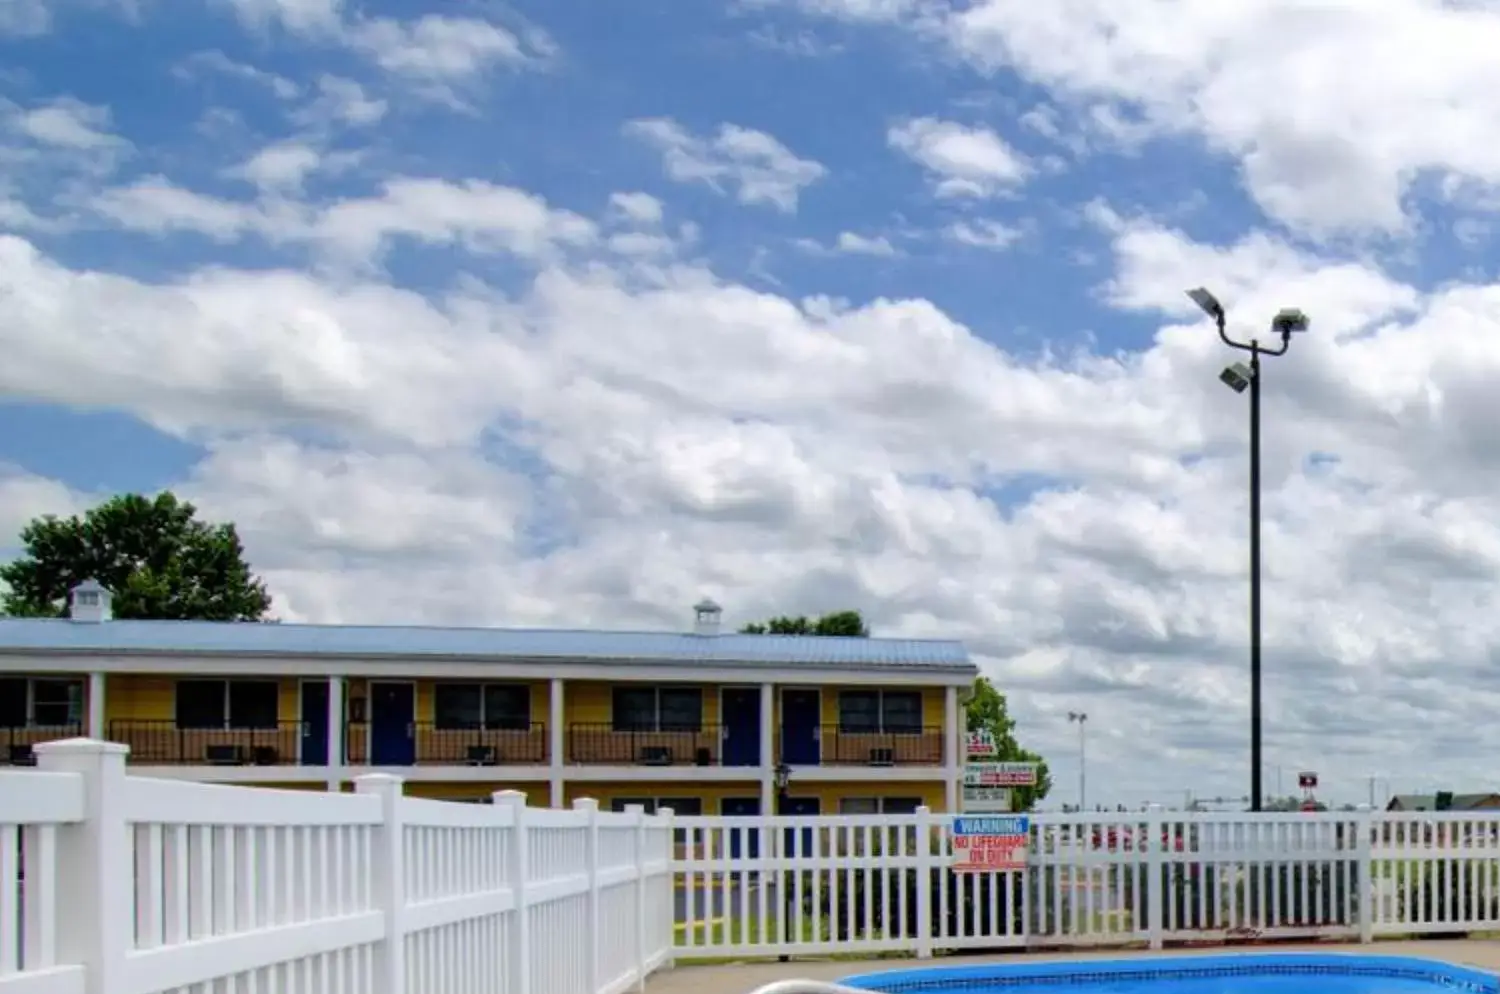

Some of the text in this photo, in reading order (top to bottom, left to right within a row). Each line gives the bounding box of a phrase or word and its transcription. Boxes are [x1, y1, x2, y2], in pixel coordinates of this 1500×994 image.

[960, 818, 1023, 833] WARNING
[955, 835, 1027, 849] NO LIFEGUARD
[970, 848, 1013, 863] ON DUTY
